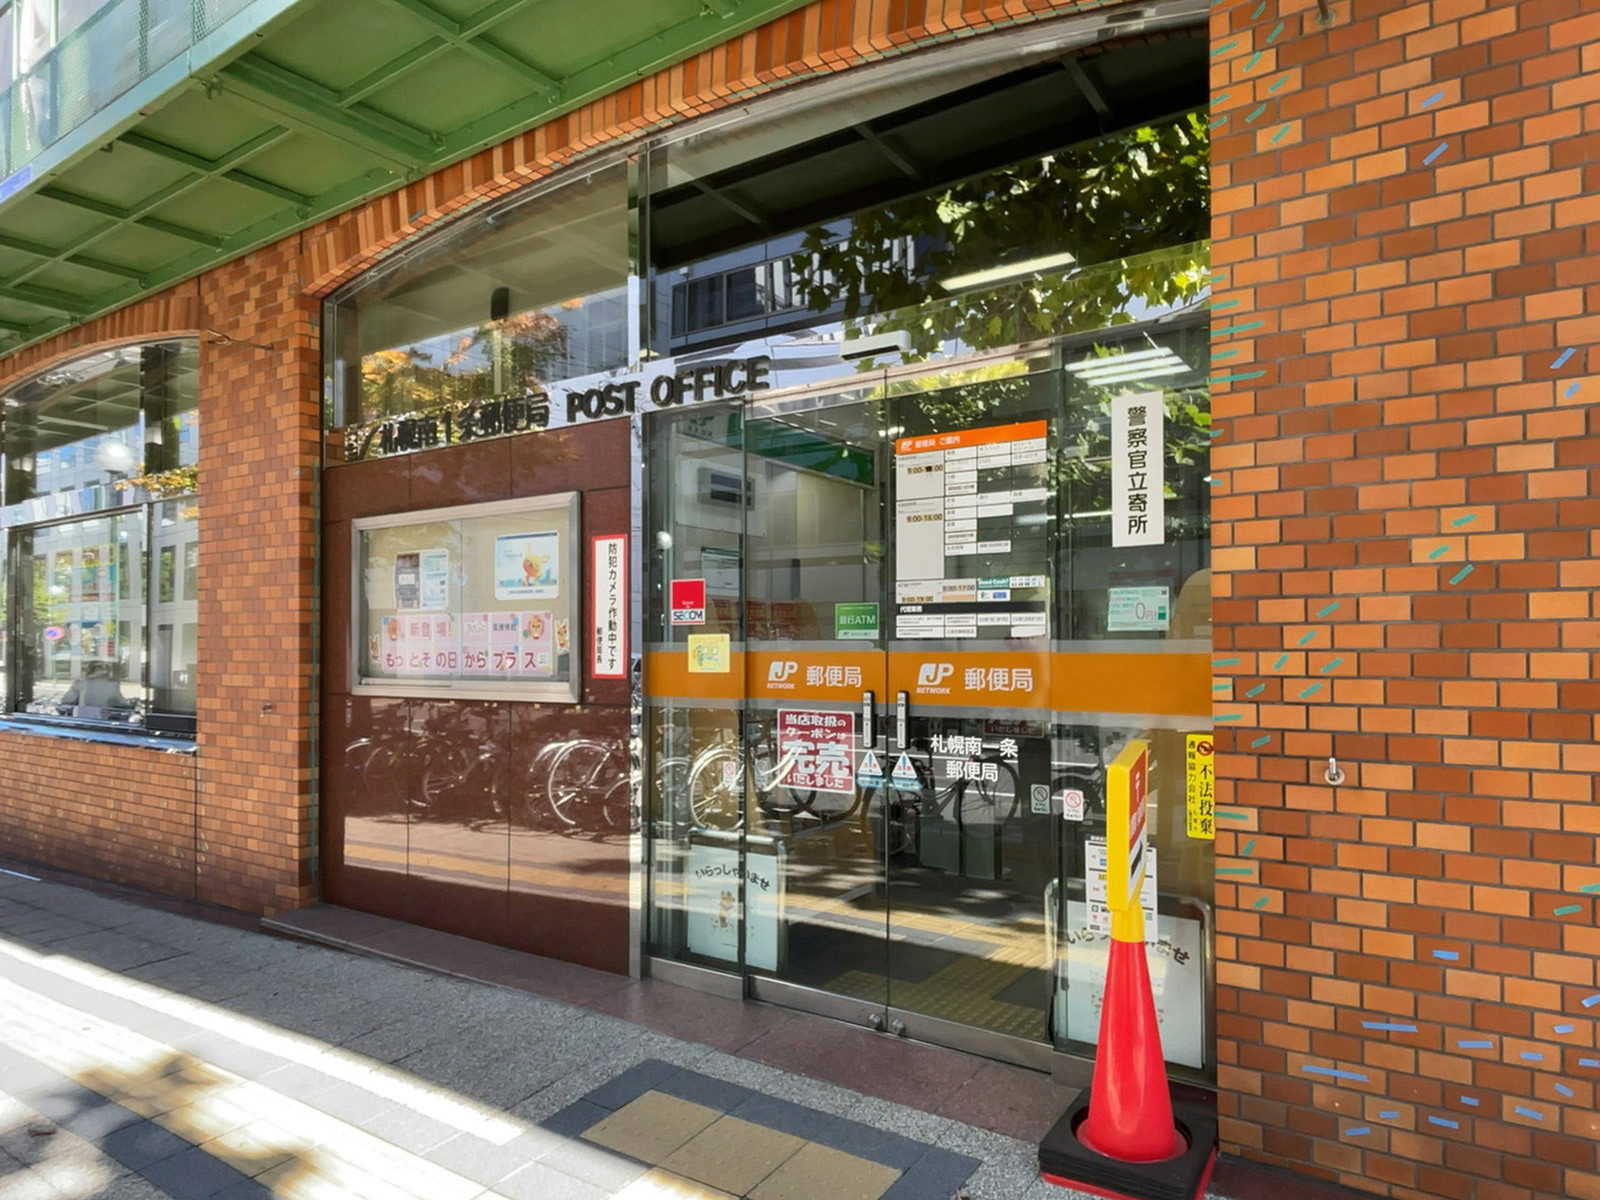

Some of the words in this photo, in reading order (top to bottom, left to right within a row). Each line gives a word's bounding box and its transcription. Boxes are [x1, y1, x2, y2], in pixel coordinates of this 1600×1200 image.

[566, 380, 641, 422] POST
[650, 354, 771, 408] OFFICE
[1127, 405, 1148, 535] 警察官立寄所
[608, 542, 618, 670] 防犯カメラ作動中です
[673, 610, 704, 621] SECOM
[385, 651, 536, 669] もっとその日からプラス
[806, 665, 862, 688] 郵便局
[964, 667, 1033, 692] 郵便局
[785, 713, 847, 727] 当店取扱の
[782, 739, 850, 777] 完売
[930, 734, 1019, 758] 札幌南一条
[946, 760, 999, 783] 郵便局
[1199, 763, 1213, 835] 不法投棄
